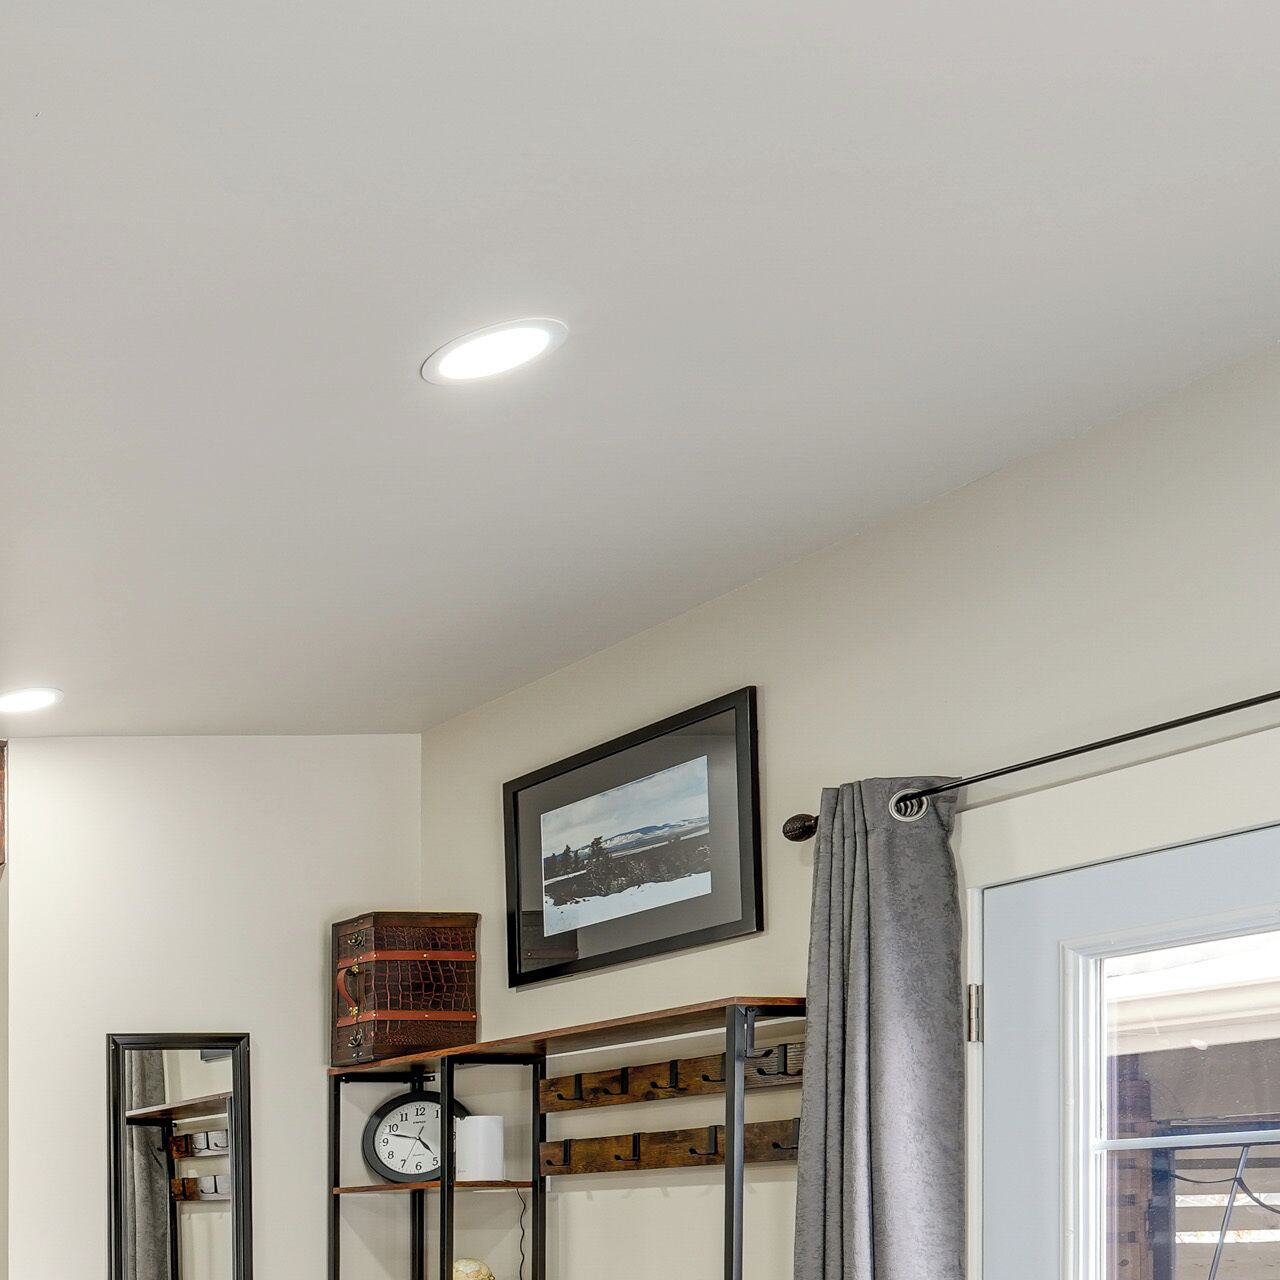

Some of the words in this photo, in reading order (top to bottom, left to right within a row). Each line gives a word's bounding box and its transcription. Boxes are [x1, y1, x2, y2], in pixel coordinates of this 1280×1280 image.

[415, 1107, 425, 1116] 12
[400, 1112, 408, 1122] 11
[389, 1124, 398, 1132] 10
[382, 1138, 388, 1146] 9
[388, 1151, 394, 1159] 8
[400, 1159, 406, 1168] 7
[432, 1157, 438, 1166] 5
[416, 1162, 422, 1170] 6
